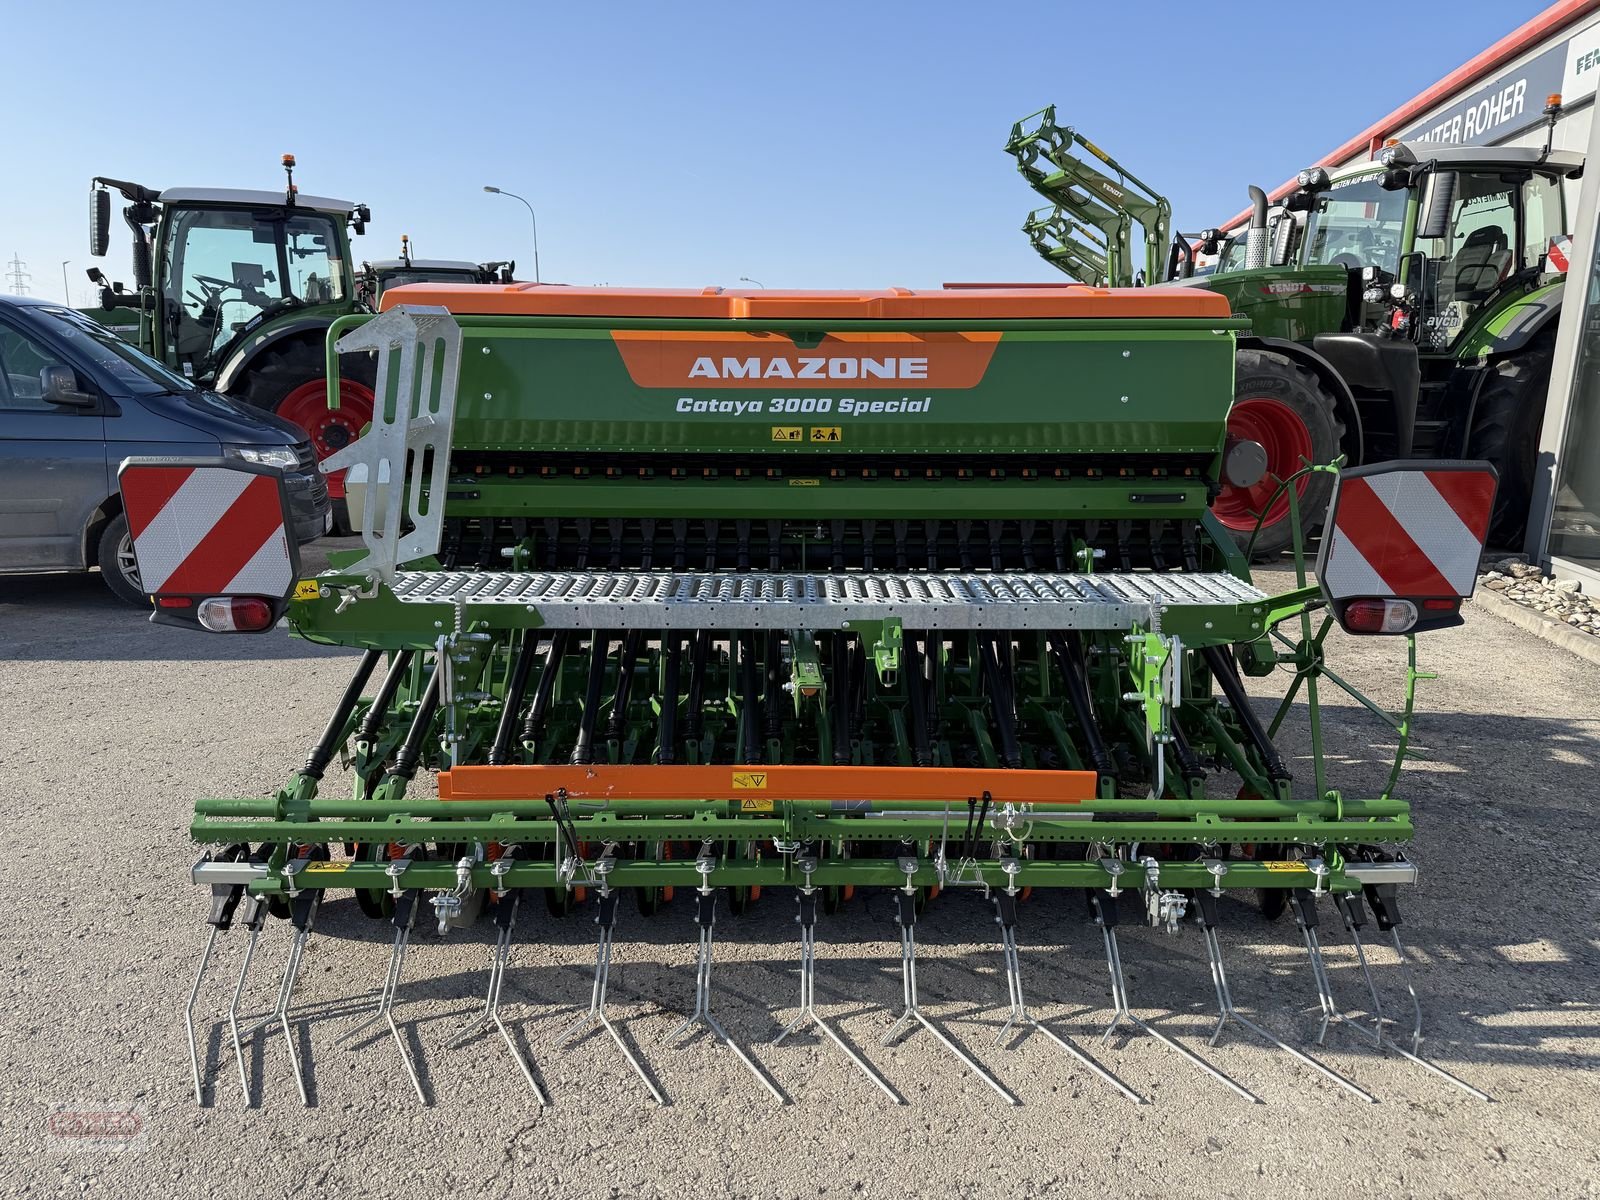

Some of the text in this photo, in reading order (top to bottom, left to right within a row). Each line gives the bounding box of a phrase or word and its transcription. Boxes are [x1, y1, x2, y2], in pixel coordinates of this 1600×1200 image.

[1463, 79, 1527, 142] ROHER
[1103, 182, 1124, 198] FENDT
[1268, 282, 1306, 293] FENDT
[688, 357, 929, 379] AMAZONE
[676, 397, 932, 416] Cataya 3000 Special
